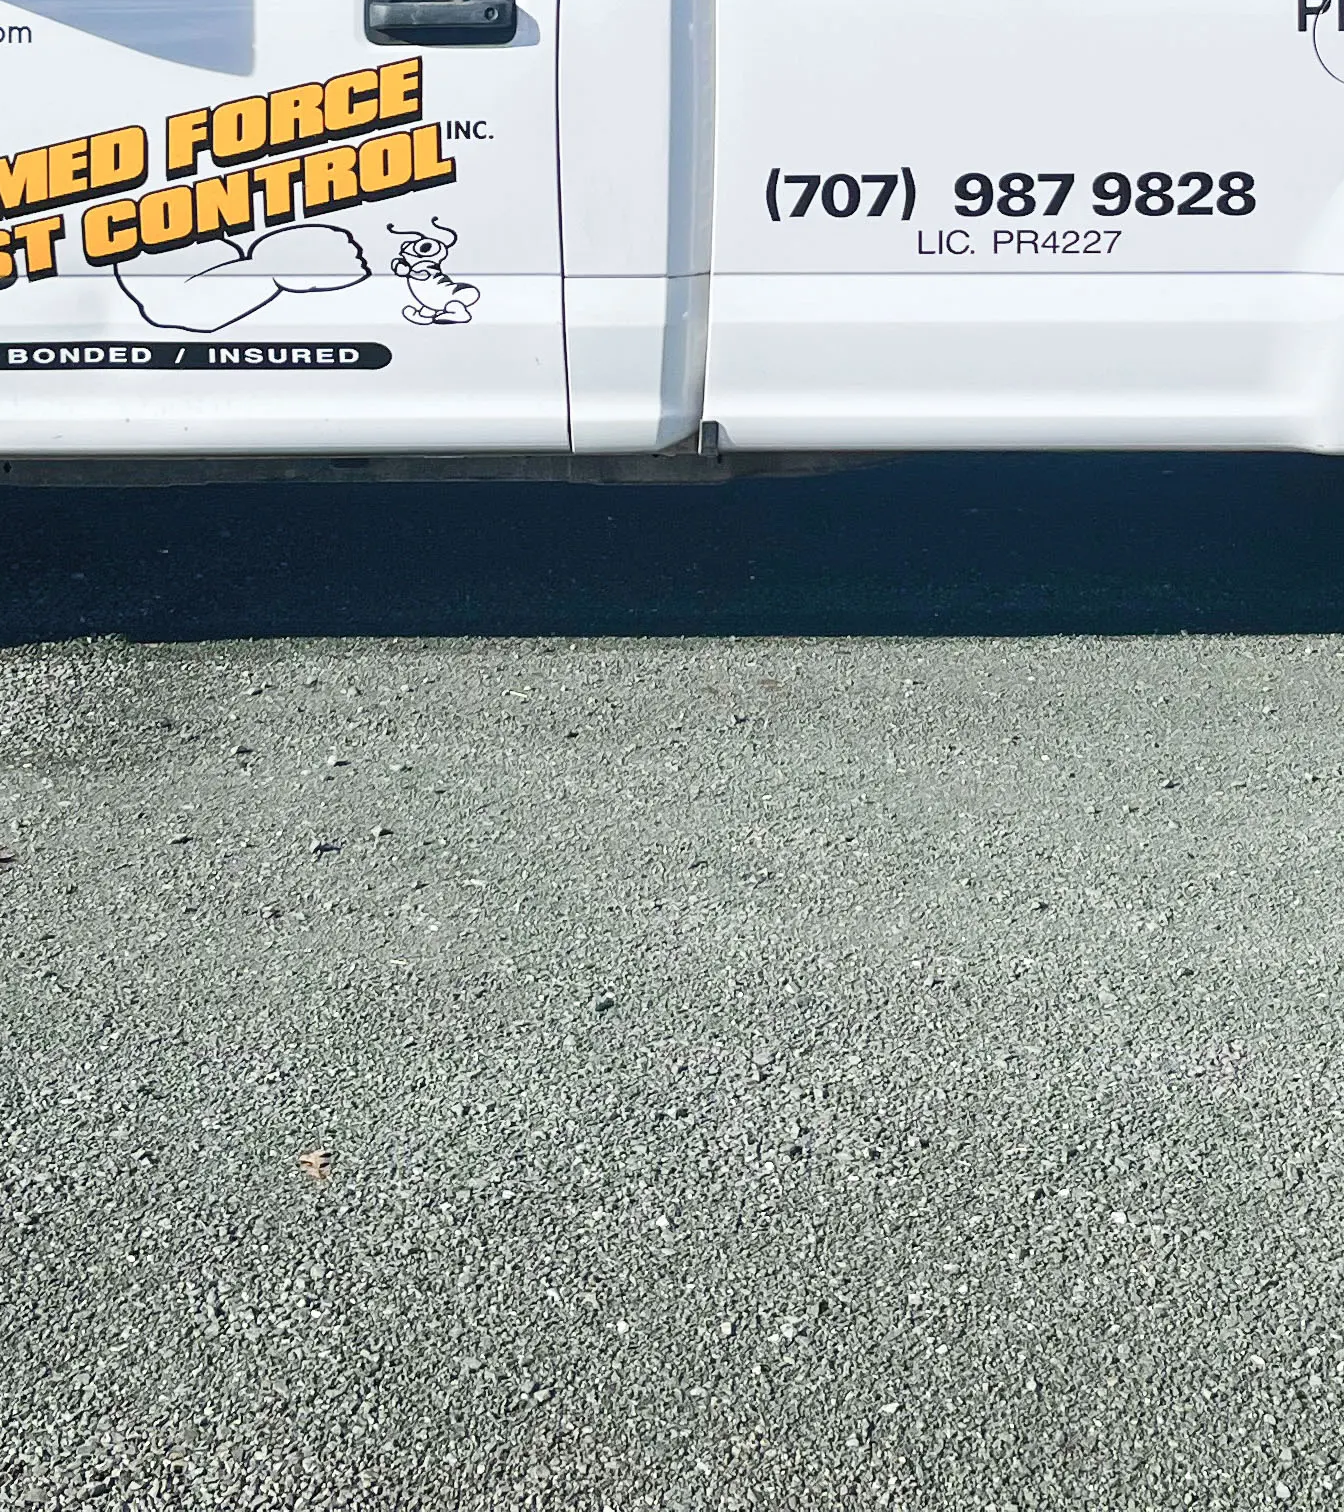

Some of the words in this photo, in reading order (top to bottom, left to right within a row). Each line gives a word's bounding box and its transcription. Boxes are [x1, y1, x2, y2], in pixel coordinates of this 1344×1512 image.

[164, 55, 424, 180] FORCE
[446, 121, 494, 140] INC.
[80, 122, 456, 267] CONTROL
[765, 167, 916, 222] (707)
[954, 172, 1075, 218] 987
[1092, 171, 1256, 217] 9828
[917, 229, 975, 255] LIC.
[993, 229, 1123, 255] PR4227
[7, 347, 152, 364] BONDED
[208, 347, 359, 364] INSURED
